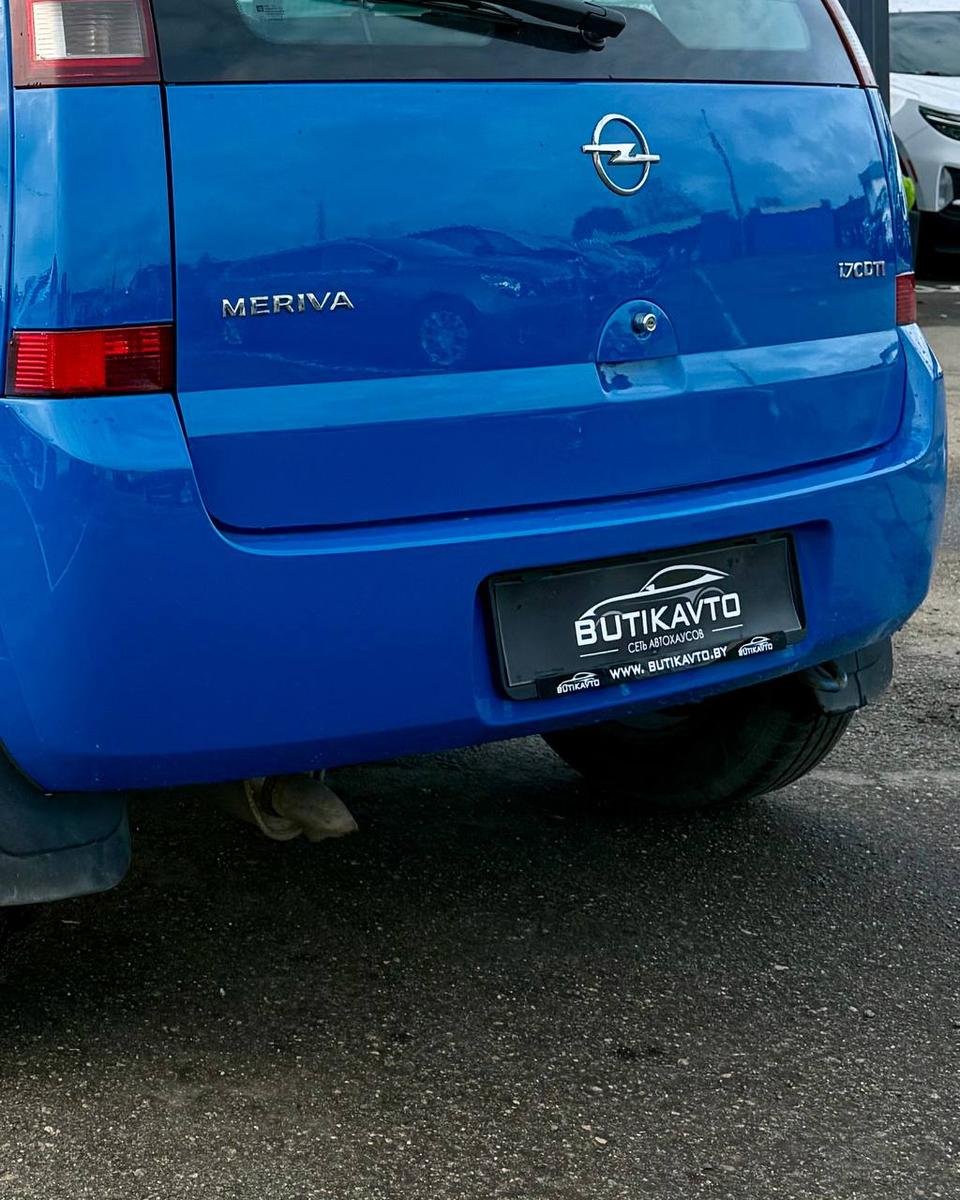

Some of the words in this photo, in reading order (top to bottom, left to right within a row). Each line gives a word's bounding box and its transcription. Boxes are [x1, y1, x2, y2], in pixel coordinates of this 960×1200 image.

[222, 291, 355, 318] MERIVA
[574, 592, 741, 647] BUTIKAVTO
[627, 641, 648, 654] СЕТЬ
[649, 629, 705, 649] АВТОХАУСОВ
[556, 678, 600, 694] BUTIKAVTO
